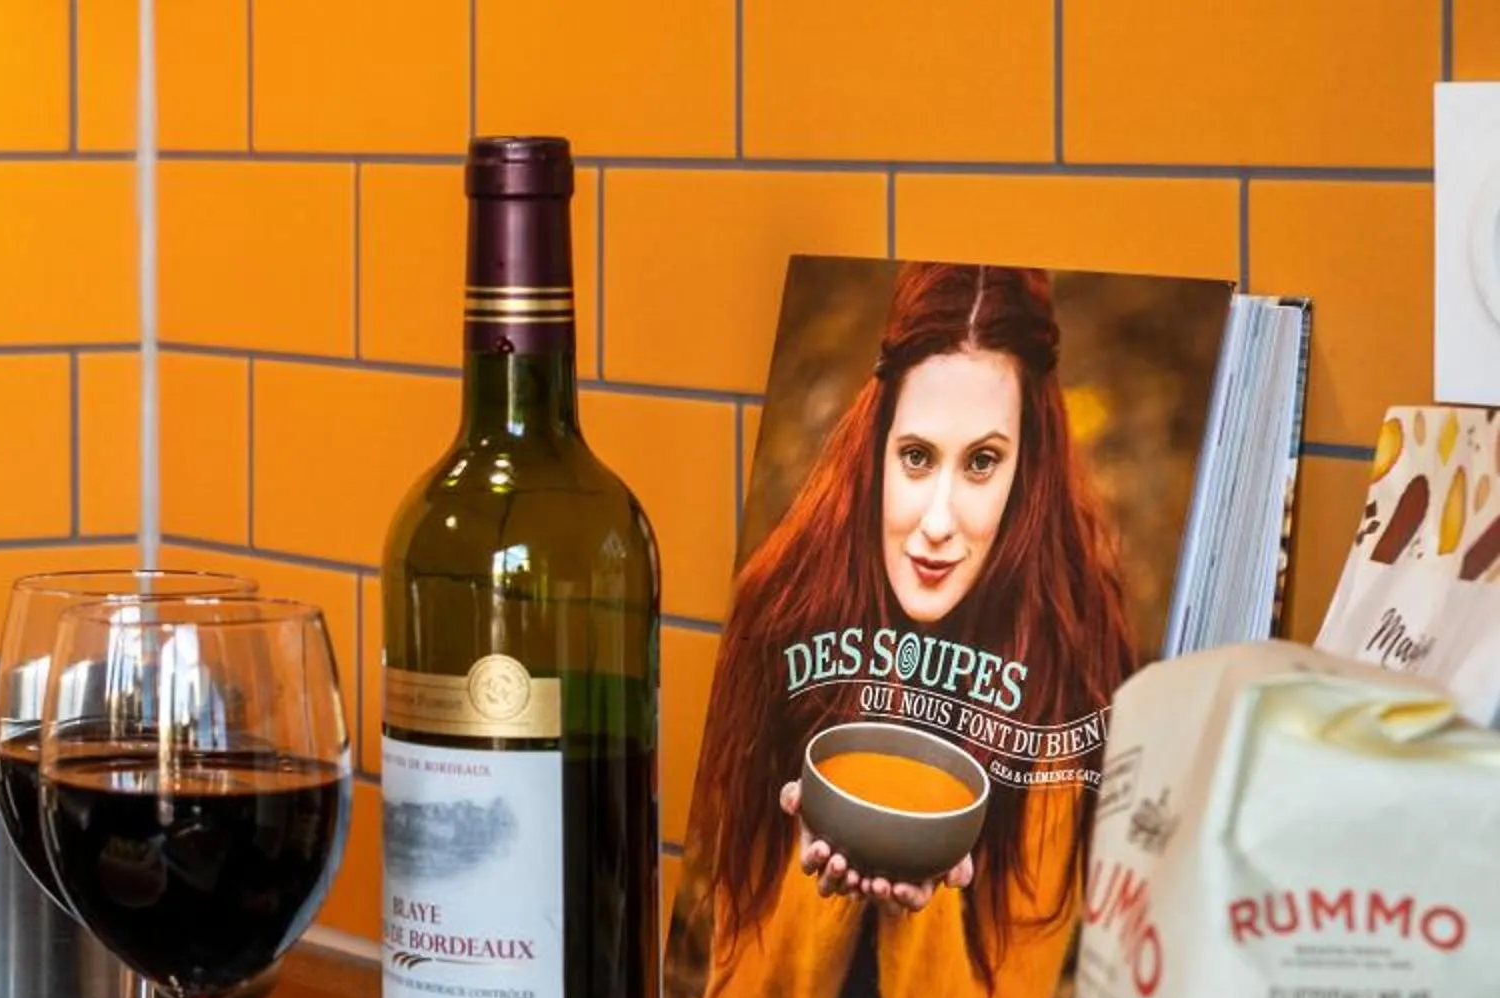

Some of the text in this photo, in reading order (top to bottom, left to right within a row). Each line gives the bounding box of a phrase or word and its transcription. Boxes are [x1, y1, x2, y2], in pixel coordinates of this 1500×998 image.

[784, 627, 1028, 712] DES SOUPES
[861, 686, 1100, 758] QUI NOUS FONT DU BIEN
[425, 761, 491, 776] BORDEAUX
[391, 924, 405, 945] DE
[409, 930, 534, 959] BORDEAUX
[393, 895, 442, 925] BLAYE
[1084, 860, 1163, 998] UMMO
[1228, 888, 1468, 952] RUMMO
